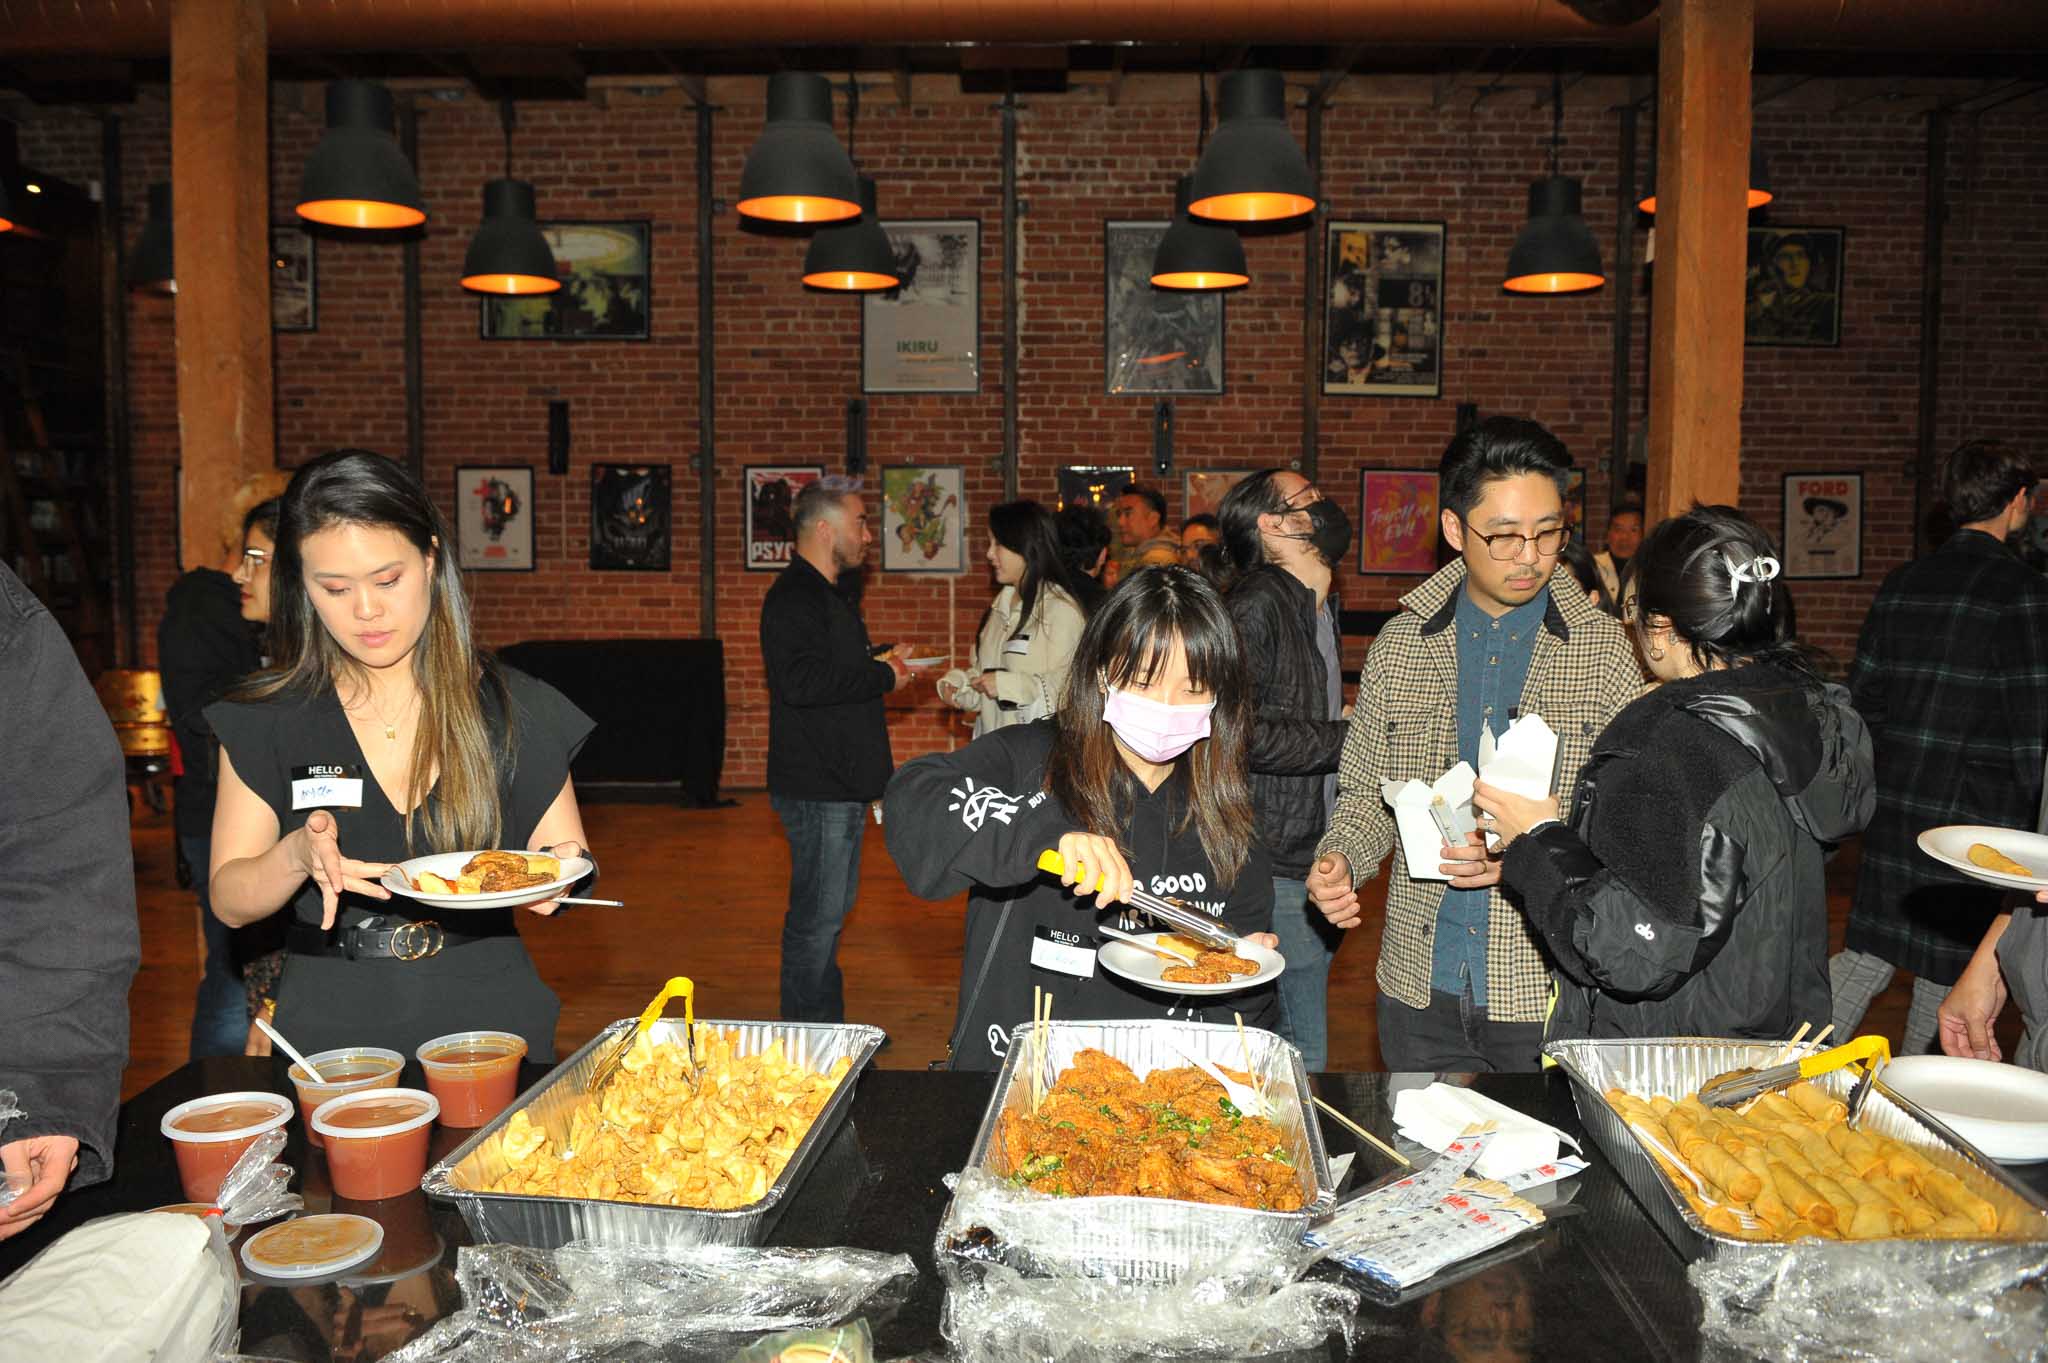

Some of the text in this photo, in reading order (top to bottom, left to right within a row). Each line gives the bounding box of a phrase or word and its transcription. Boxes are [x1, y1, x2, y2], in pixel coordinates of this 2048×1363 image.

[896, 339, 939, 353] IKIRU
[1797, 481, 1848, 496] FORD
[308, 765, 343, 775] HELLO
[1028, 791, 1047, 809] BUY
[1151, 872, 1207, 896] GOOD
[1050, 929, 1080, 943] HELLO
